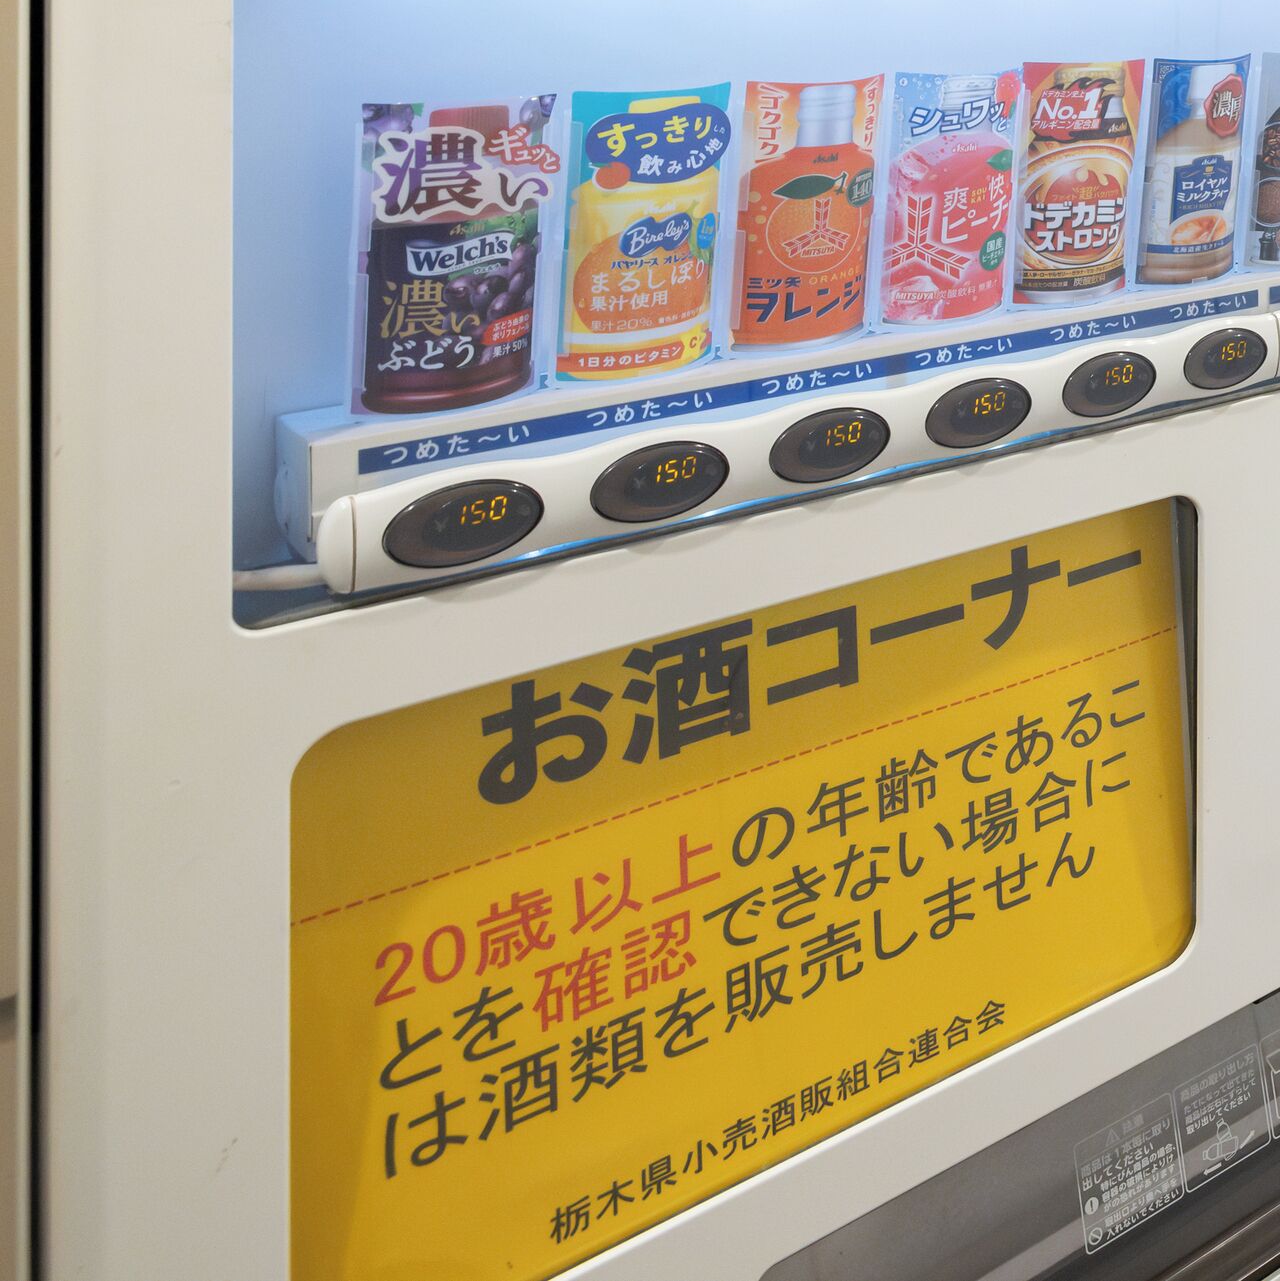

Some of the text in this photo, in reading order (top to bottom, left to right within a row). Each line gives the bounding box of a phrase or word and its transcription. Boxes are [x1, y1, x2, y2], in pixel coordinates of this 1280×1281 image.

[758, 93, 785, 156] ゴクゴク
[1035, 90, 1102, 122] No.1
[488, 127, 559, 170] ギュッと
[636, 138, 723, 177] 飲み心地
[380, 132, 549, 217] 濃い
[1180, 176, 1229, 192] ロイヤル
[1176, 187, 1230, 204] ミルクティー
[410, 236, 508, 272] Welch's
[801, 245, 837, 259] MITSUYA
[1035, 225, 1120, 253] ストロング
[590, 290, 668, 313] 果汁使用
[747, 276, 801, 291] 三ツ矢
[380, 279, 481, 339] 濃い
[377, 336, 476, 372] ぶどう
[973, 391, 1007, 417] 150
[826, 420, 862, 448] 150
[655, 455, 698, 485] 150
[459, 495, 508, 526] 150
[476, 543, 1143, 808] お酒コーナー
[373, 680, 1148, 1010] 20歳以上の年齢であるこ
[378, 749, 1134, 1093] とを確認できない場合に
[382, 831, 1099, 1179] は酒類を販売しません
[548, 998, 1007, 1246] 栃木県小売酒販組合連合会
[1186, 1091, 1252, 1136] 取り出してください
[1082, 1141, 1155, 1193] 出してください
[1106, 1188, 1181, 1241] 入れないでください
